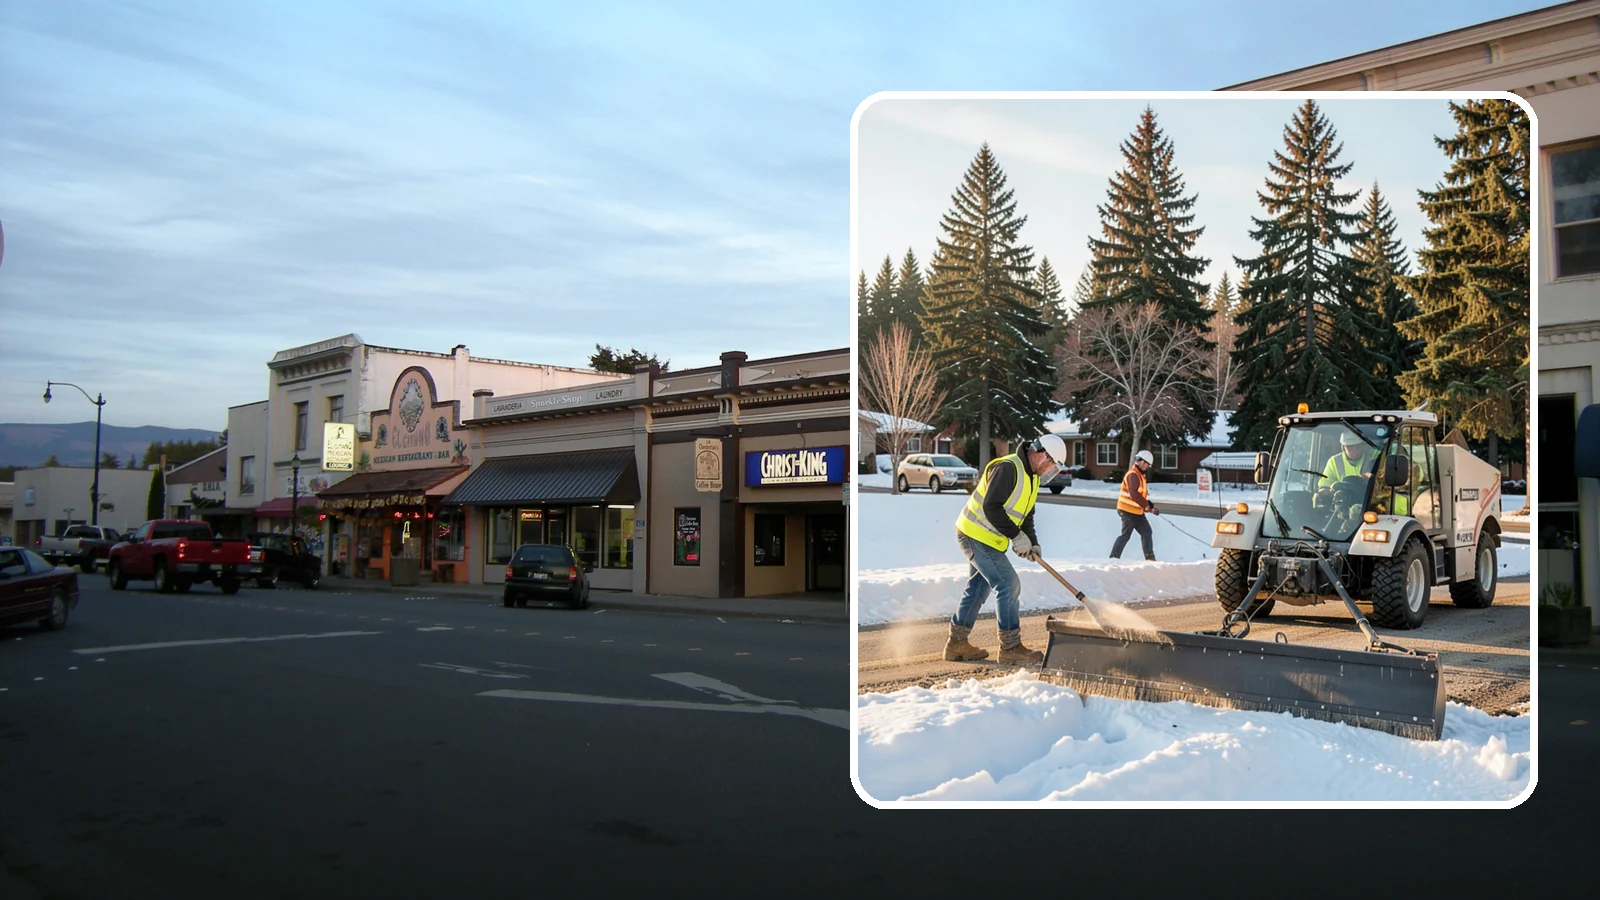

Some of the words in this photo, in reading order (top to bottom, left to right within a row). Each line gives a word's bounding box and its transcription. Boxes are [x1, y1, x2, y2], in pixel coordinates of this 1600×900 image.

[562, 394, 582, 404] Shop
[595, 388, 623, 400] LAUNDRY
[493, 402, 522, 412] LAVANDERIA
[373, 455, 396, 464] MEXICAN
[397, 452, 433, 462] RESTAURANT
[438, 450, 450, 459] BAR
[761, 452, 797, 478] CHRIST
[799, 450, 827, 476] KING
